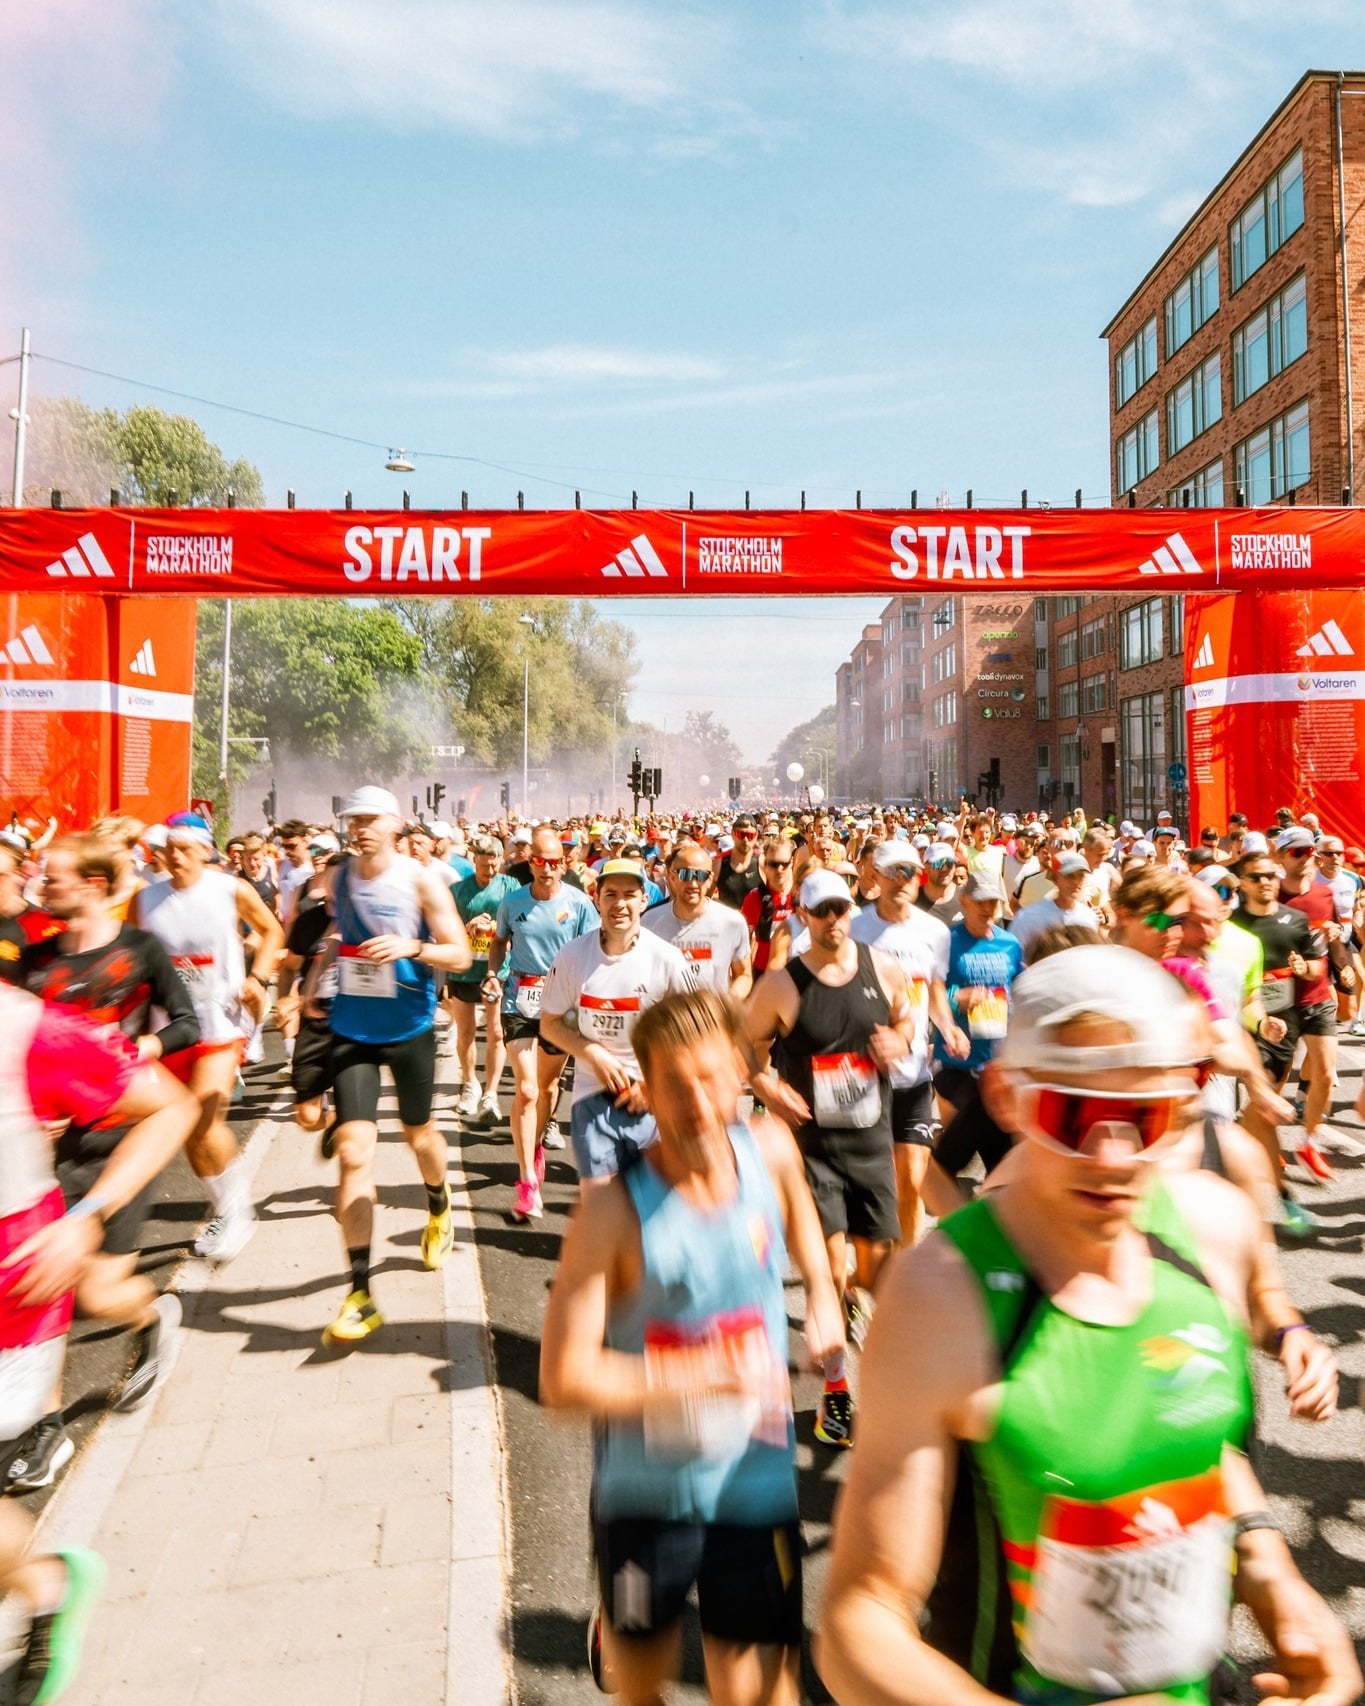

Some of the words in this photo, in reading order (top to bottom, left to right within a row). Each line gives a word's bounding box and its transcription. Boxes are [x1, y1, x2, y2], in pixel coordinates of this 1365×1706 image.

[147, 536, 233, 553] STOCKHOLM
[699, 537, 782, 555] STOCKHOLM
[1231, 534, 1311, 551] STOCKHOLM
[343, 525, 491, 582] START
[890, 525, 1031, 580] START
[1231, 552, 1312, 569] MARATHON
[146, 555, 233, 573] MARATHON
[699, 556, 782, 573] MARATHON
[1312, 678, 1357, 689] Voltaren
[4, 686, 54, 700] Voltaren
[978, 689, 1008, 698] Circura
[994, 708, 1021, 718] Valu8
[592, 1014, 624, 1030] 29721
